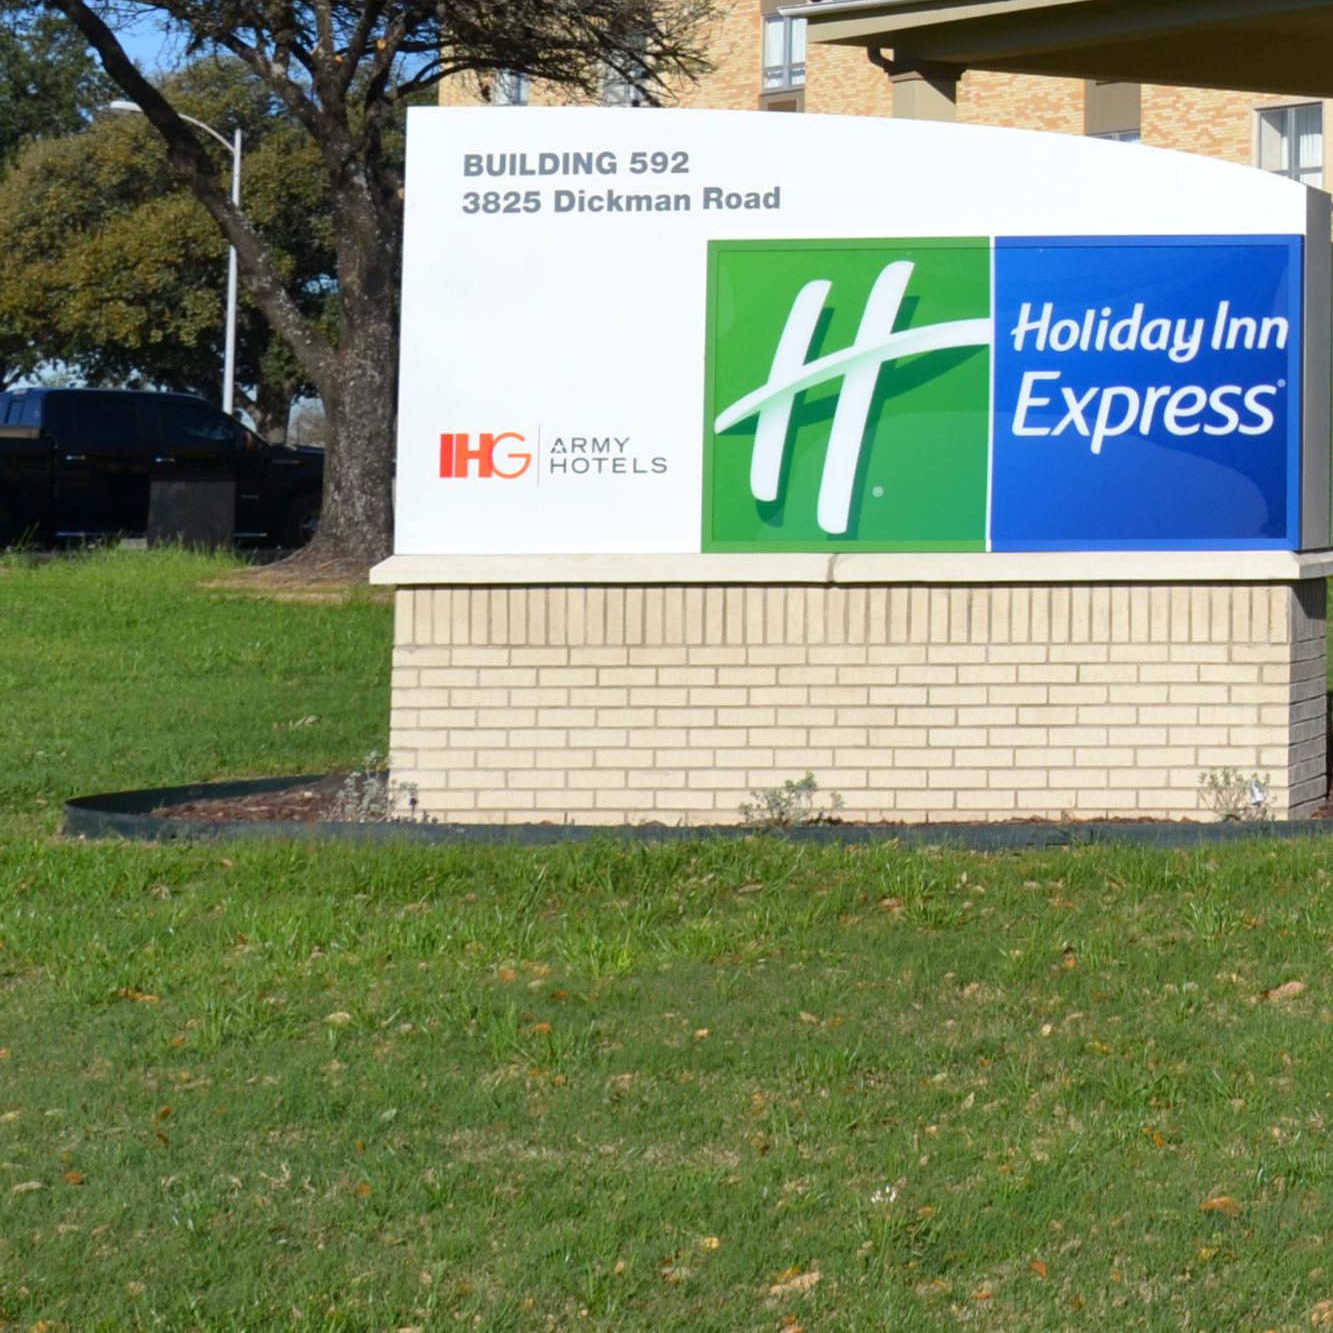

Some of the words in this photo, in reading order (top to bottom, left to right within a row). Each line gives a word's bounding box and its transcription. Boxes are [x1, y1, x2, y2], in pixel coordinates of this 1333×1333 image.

[463, 151, 618, 177] BUILDING
[629, 150, 690, 175] 592
[461, 190, 542, 215] 3825
[554, 188, 691, 213] Dickman
[702, 185, 781, 210] Road
[1011, 302, 1204, 363] Holiday
[1211, 300, 1289, 350] Inn
[439, 431, 532, 479] IHG
[550, 437, 630, 454] ARMY
[550, 456, 668, 475] HOTELS
